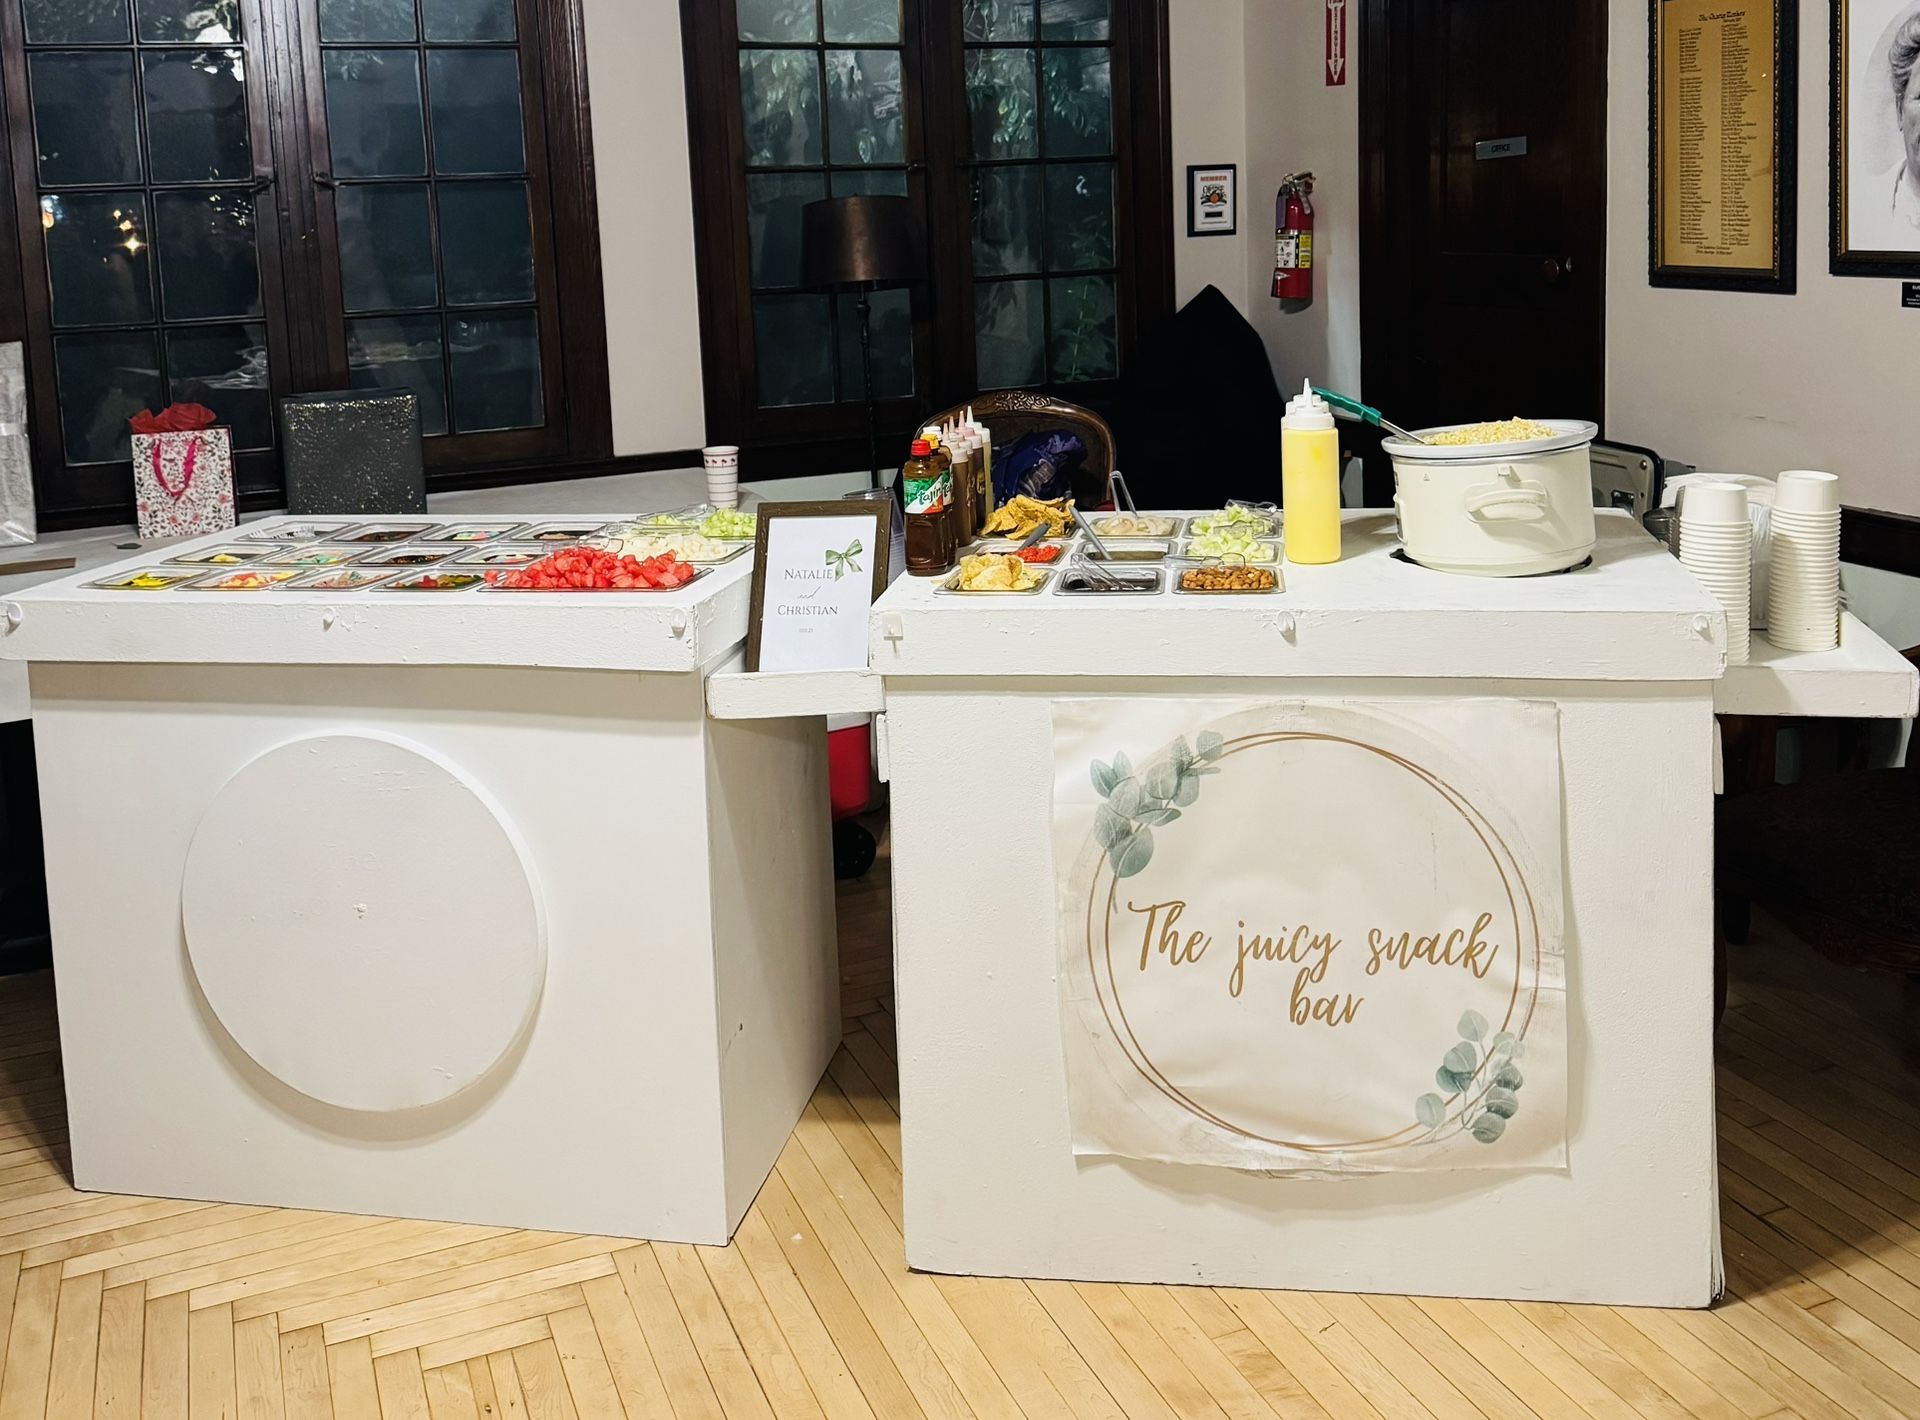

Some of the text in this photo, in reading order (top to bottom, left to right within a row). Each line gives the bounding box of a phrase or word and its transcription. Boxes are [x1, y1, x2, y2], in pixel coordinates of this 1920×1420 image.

[784, 568, 833, 580] NATALIE
[777, 604, 838, 616] CHRISTIAN
[1127, 900, 1500, 998] The juicy snack
[1289, 967, 1365, 1027] bar
